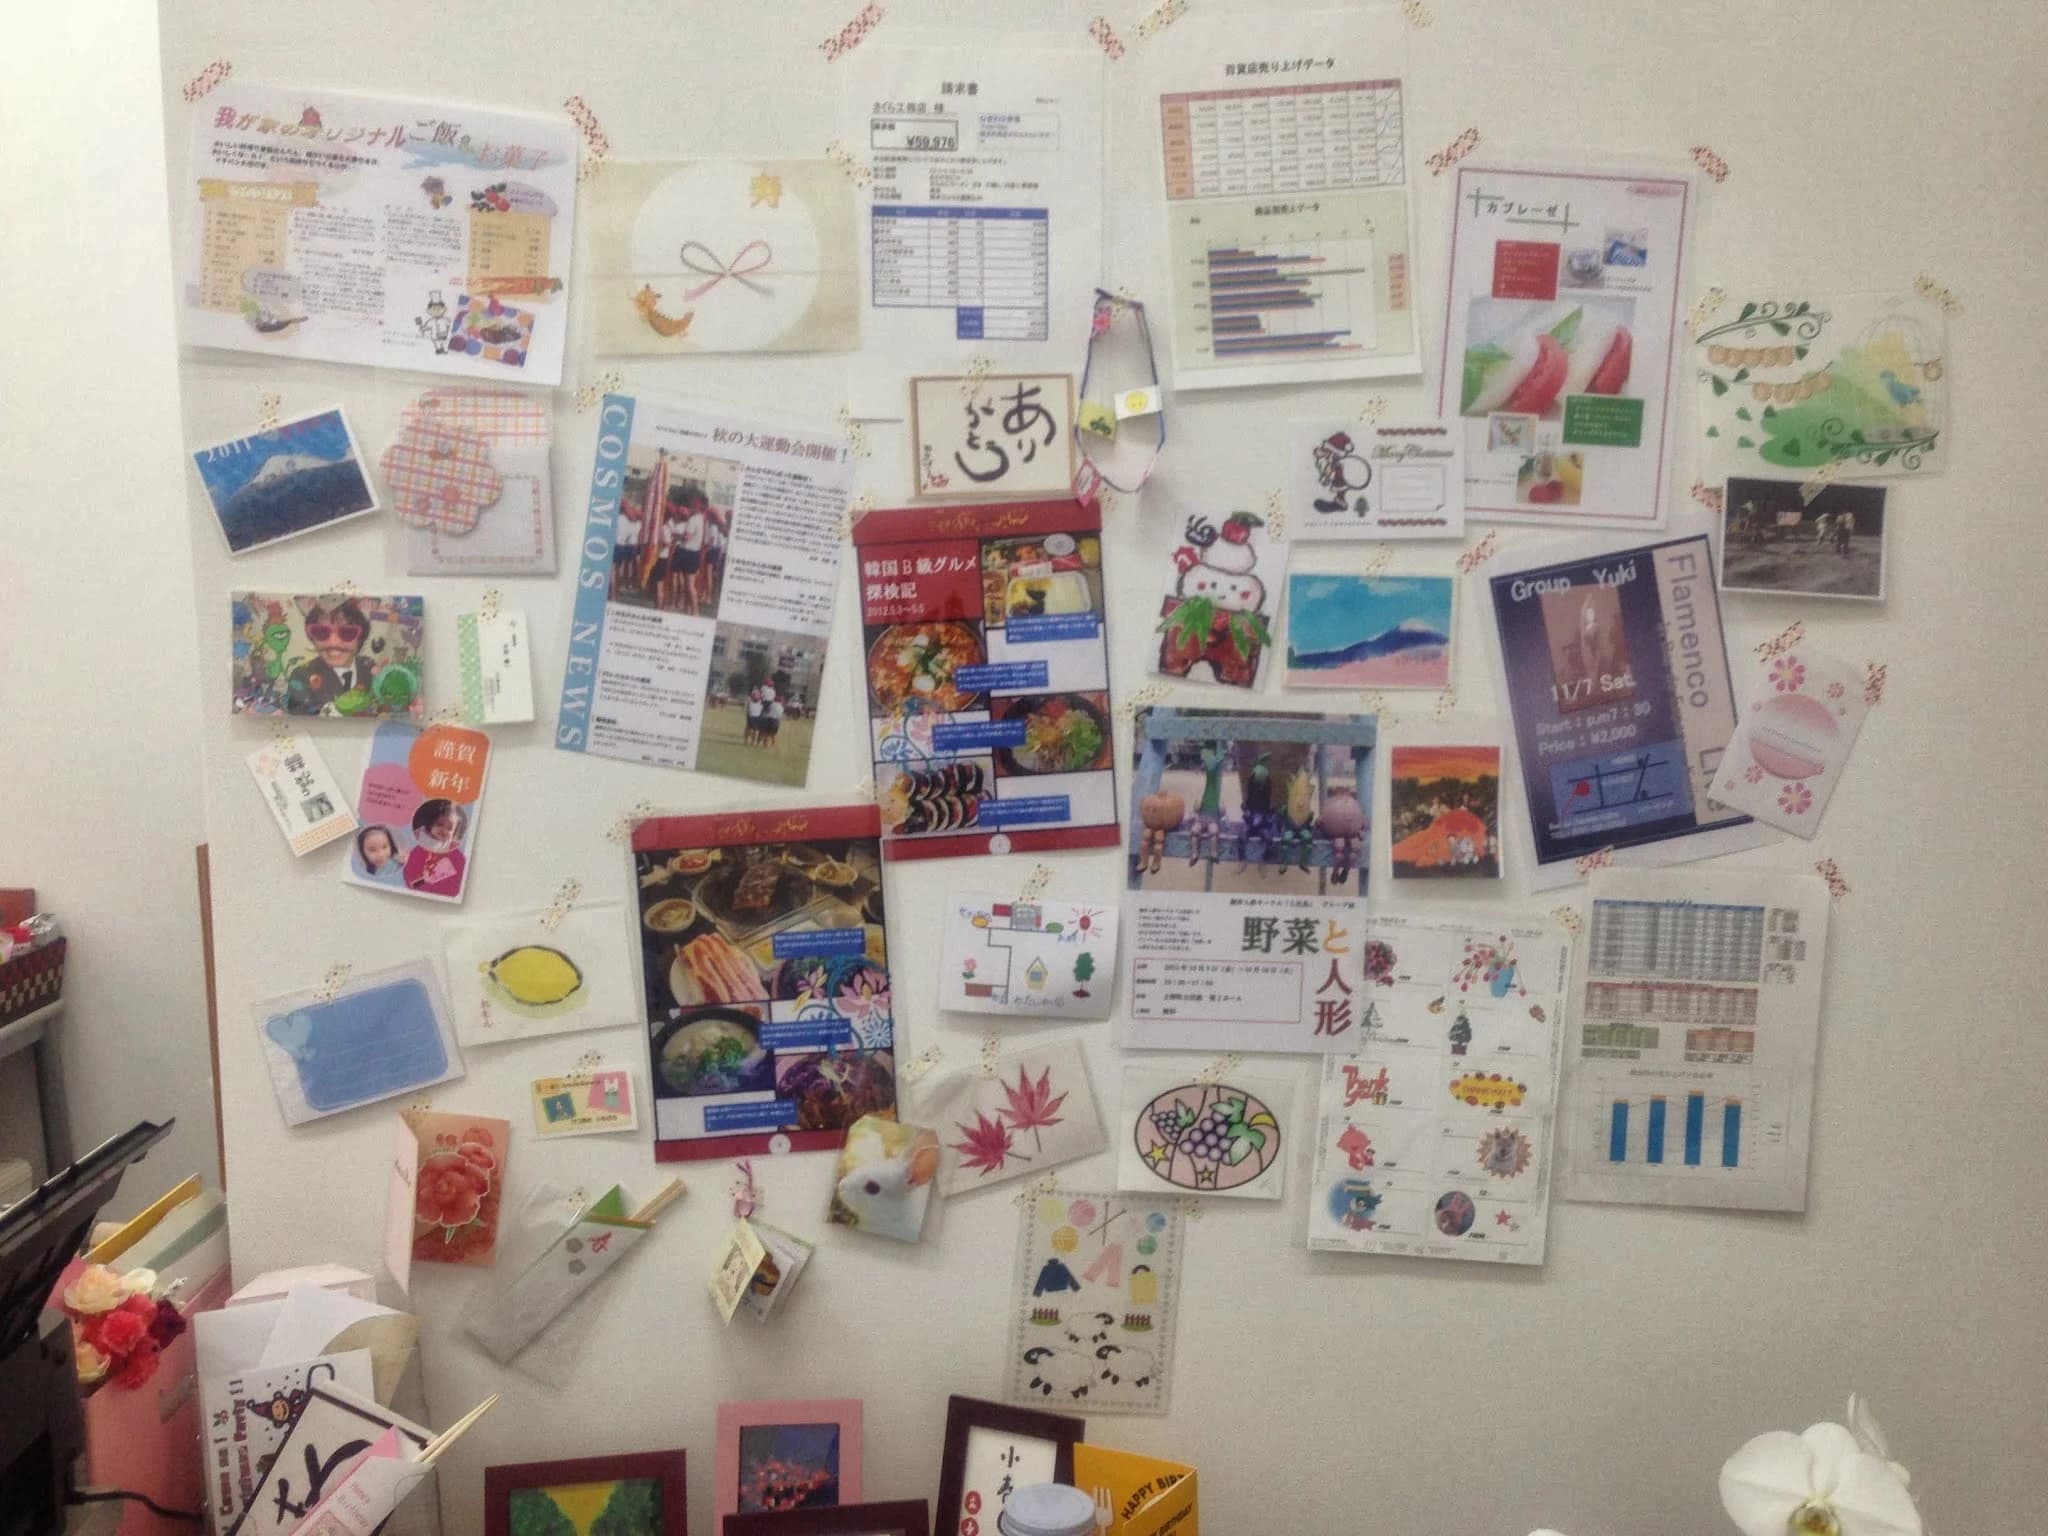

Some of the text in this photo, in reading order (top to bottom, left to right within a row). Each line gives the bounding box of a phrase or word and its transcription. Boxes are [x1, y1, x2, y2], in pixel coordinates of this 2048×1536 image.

[558, 404, 628, 746] COSMOS NEWS
[1510, 560, 1637, 602] Group Yuki
[1666, 553, 1709, 708] Flamenco
[1550, 682, 1593, 702] 11/7
[1314, 958, 1353, 1036] 人形
[1121, 1482, 1154, 1520] HAPPY
